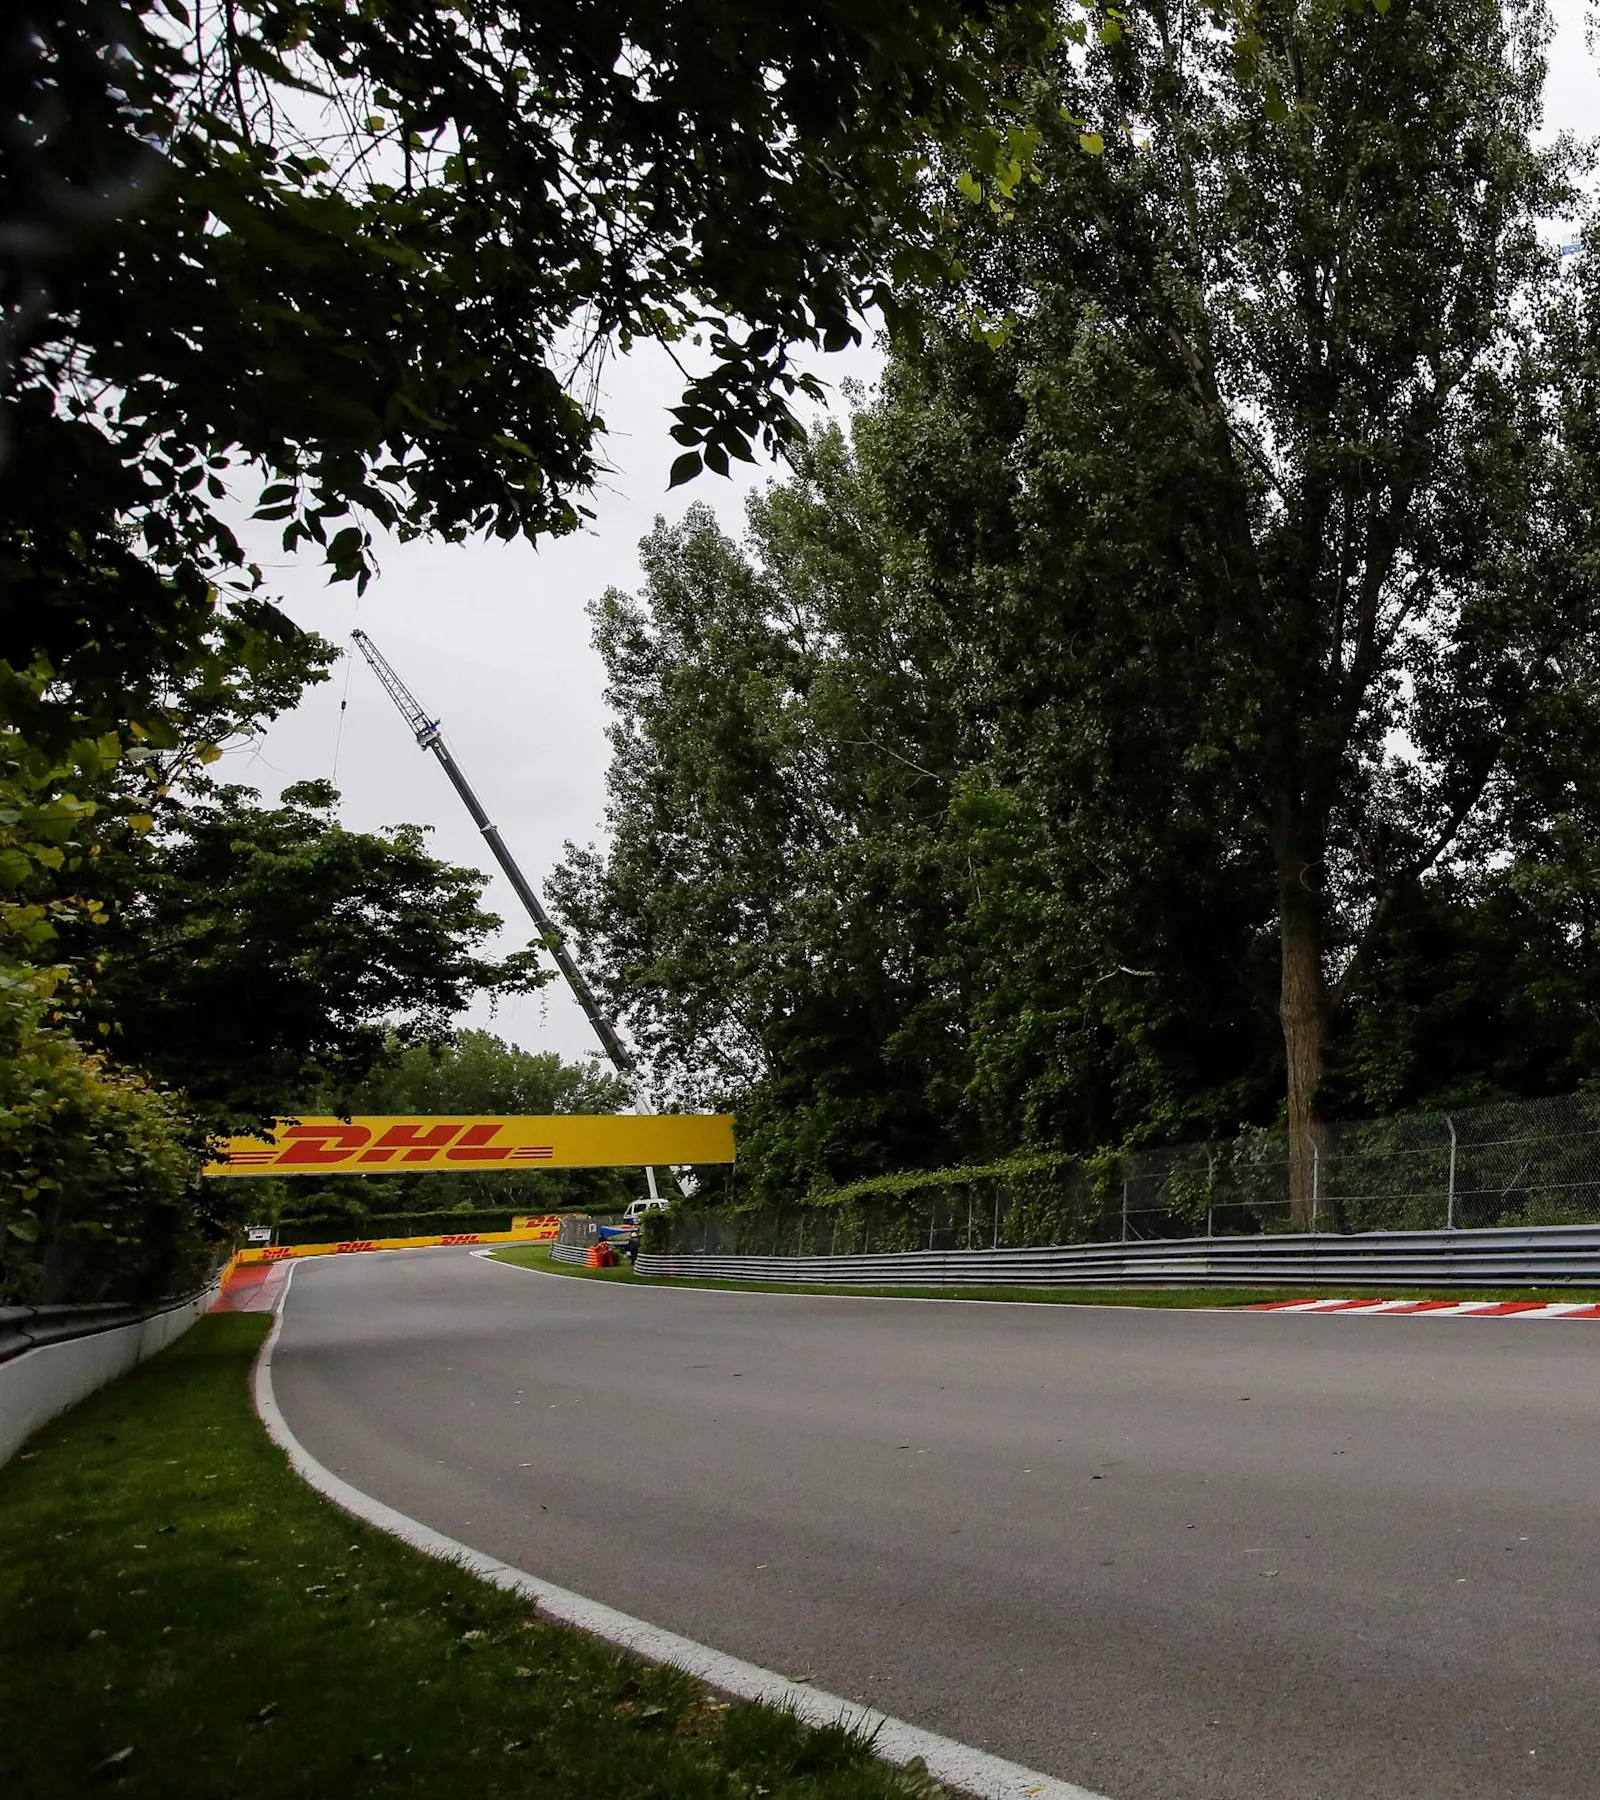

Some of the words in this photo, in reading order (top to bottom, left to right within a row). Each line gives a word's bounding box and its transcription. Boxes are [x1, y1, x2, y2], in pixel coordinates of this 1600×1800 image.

[273, 1124, 514, 1164] DHL
[440, 1235, 480, 1245] DHL
[262, 1247, 292, 1259] DHL
[337, 1242, 374, 1253] DHL
